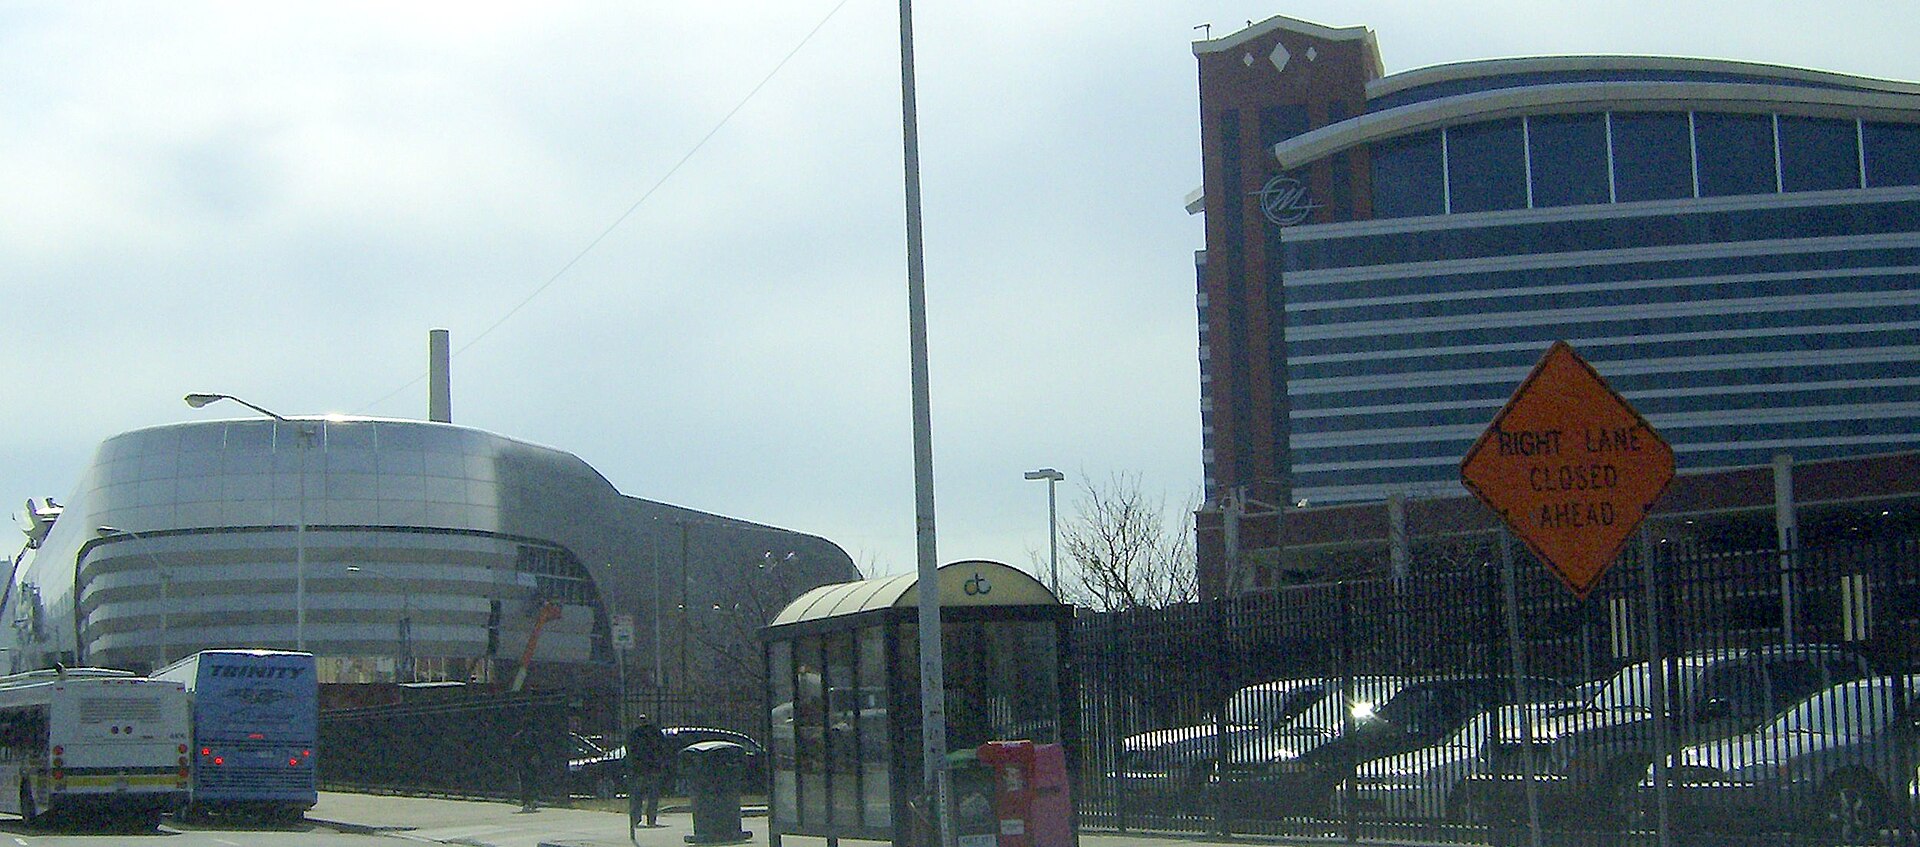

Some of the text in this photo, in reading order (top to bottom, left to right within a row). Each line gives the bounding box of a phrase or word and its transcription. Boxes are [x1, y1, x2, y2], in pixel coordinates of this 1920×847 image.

[1500, 427, 1641, 456] RIGHT LANE
[1530, 463, 1617, 492] CLOSED
[1540, 501, 1614, 528] AHEAD
[211, 664, 306, 679] TRINITY
